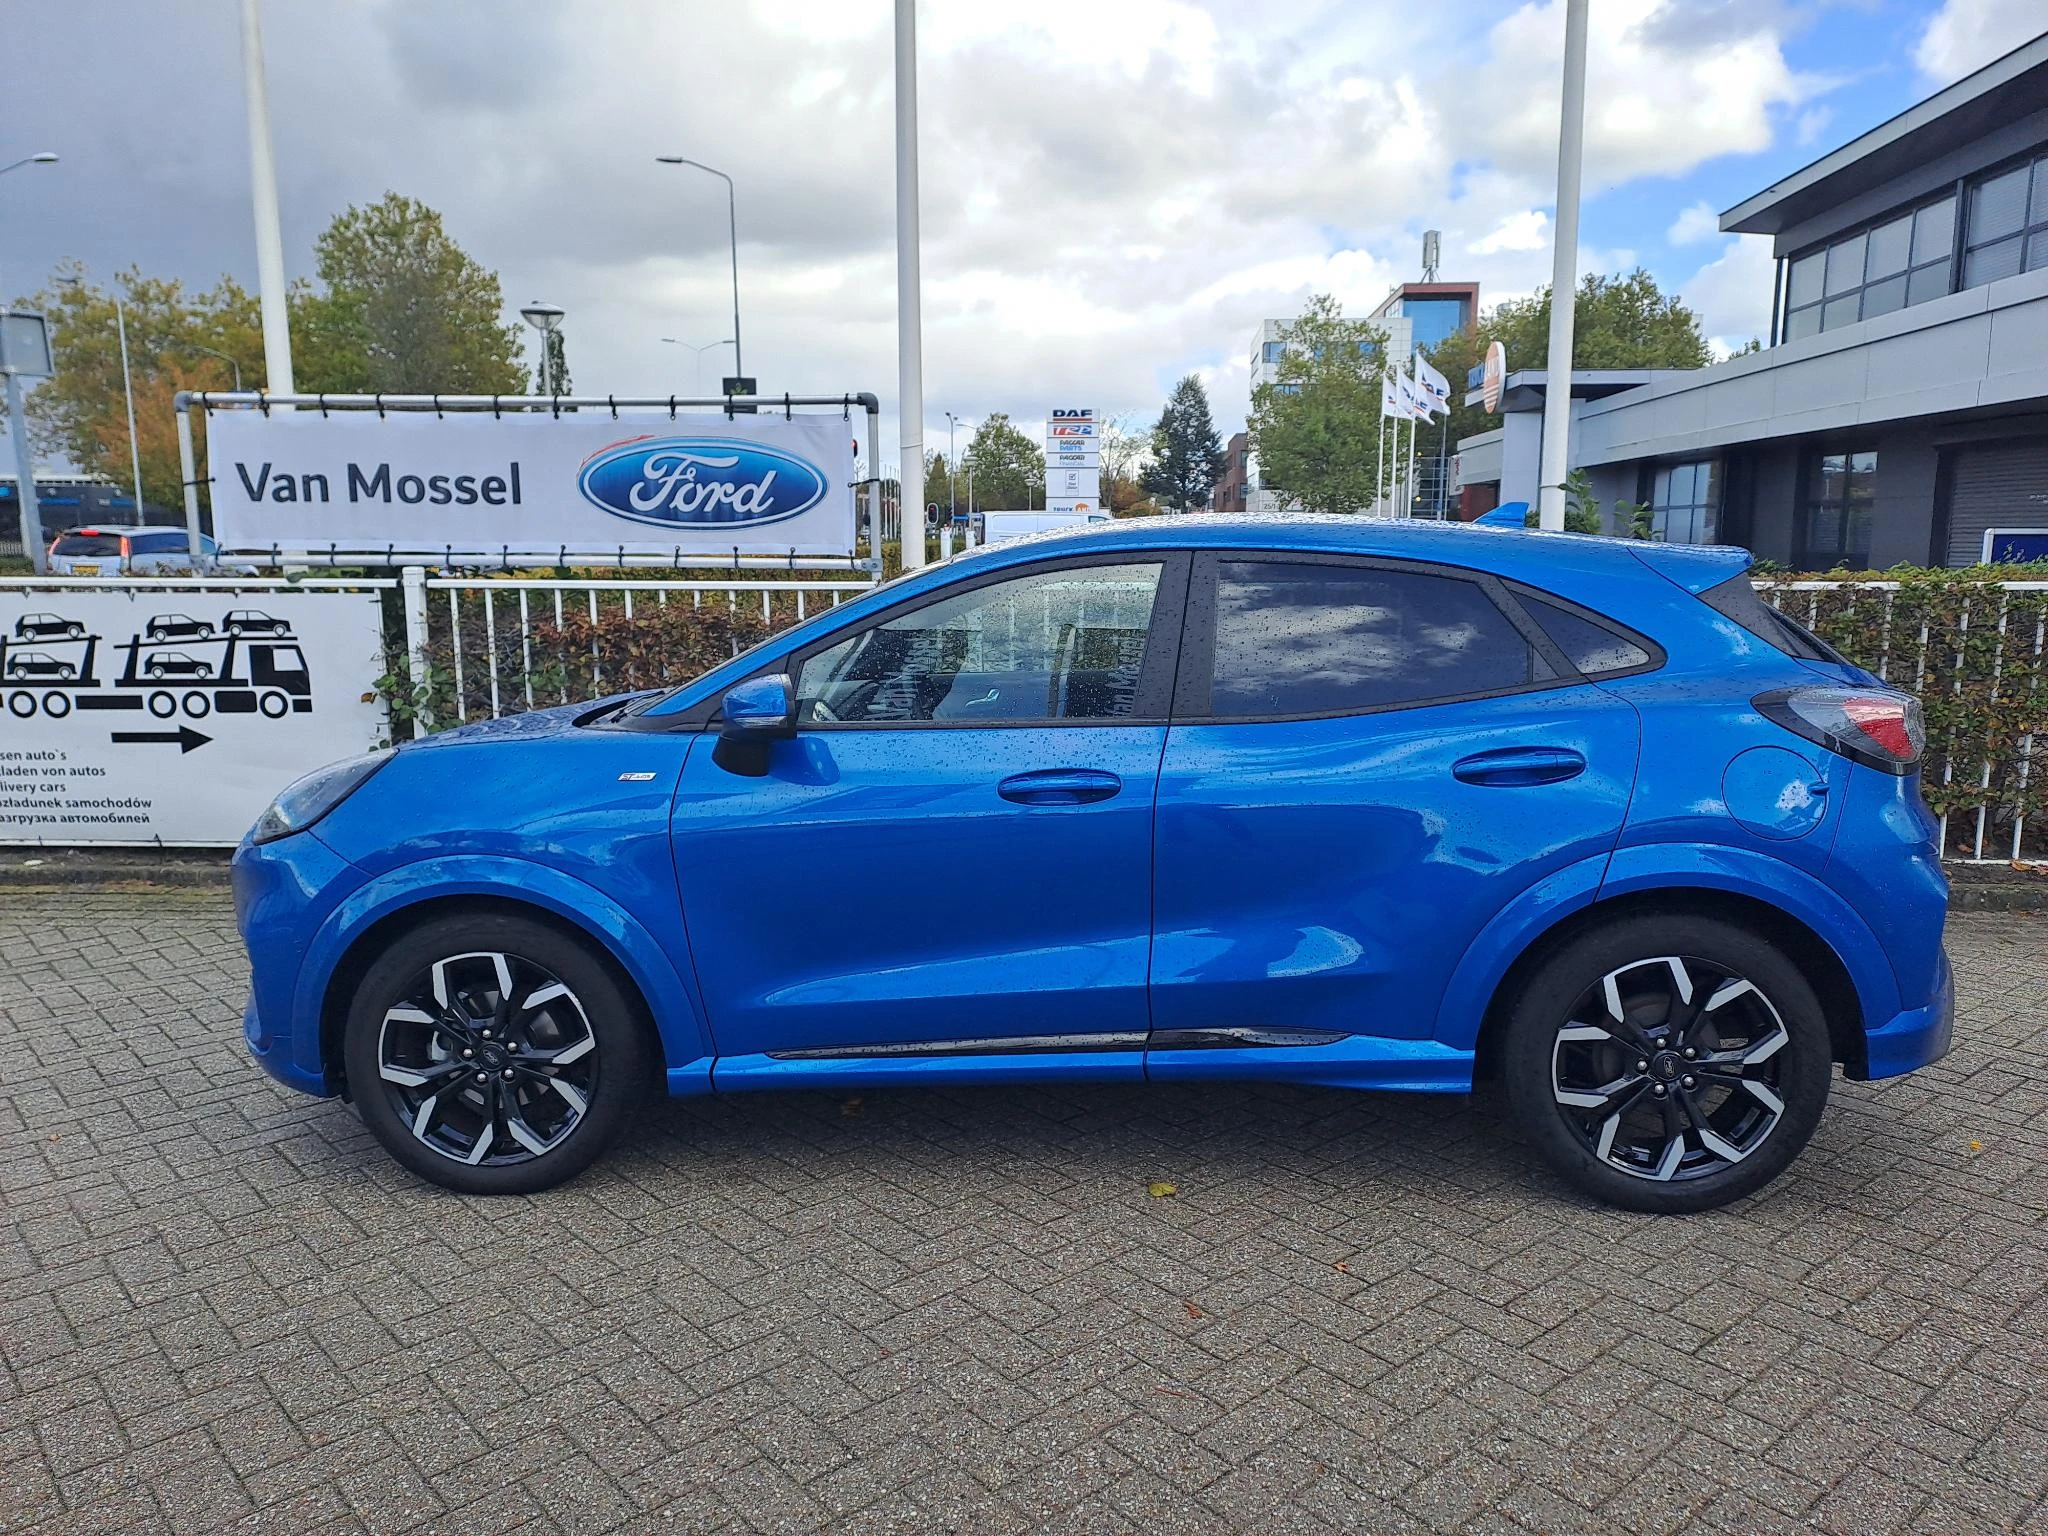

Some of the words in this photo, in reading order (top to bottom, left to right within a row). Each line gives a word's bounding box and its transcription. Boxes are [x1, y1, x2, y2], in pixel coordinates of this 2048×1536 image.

[1052, 409, 1092, 417] DAF
[235, 462, 330, 503] Van
[347, 461, 522, 505] Mossel
[629, 451, 778, 514] Ford
[0, 764, 38, 776] laden
[41, 767, 66, 776] von
[69, 765, 106, 777] autos
[40, 783, 67, 793] cars
[65, 796, 152, 809] samochodów
[60, 811, 151, 824] автомобилей
